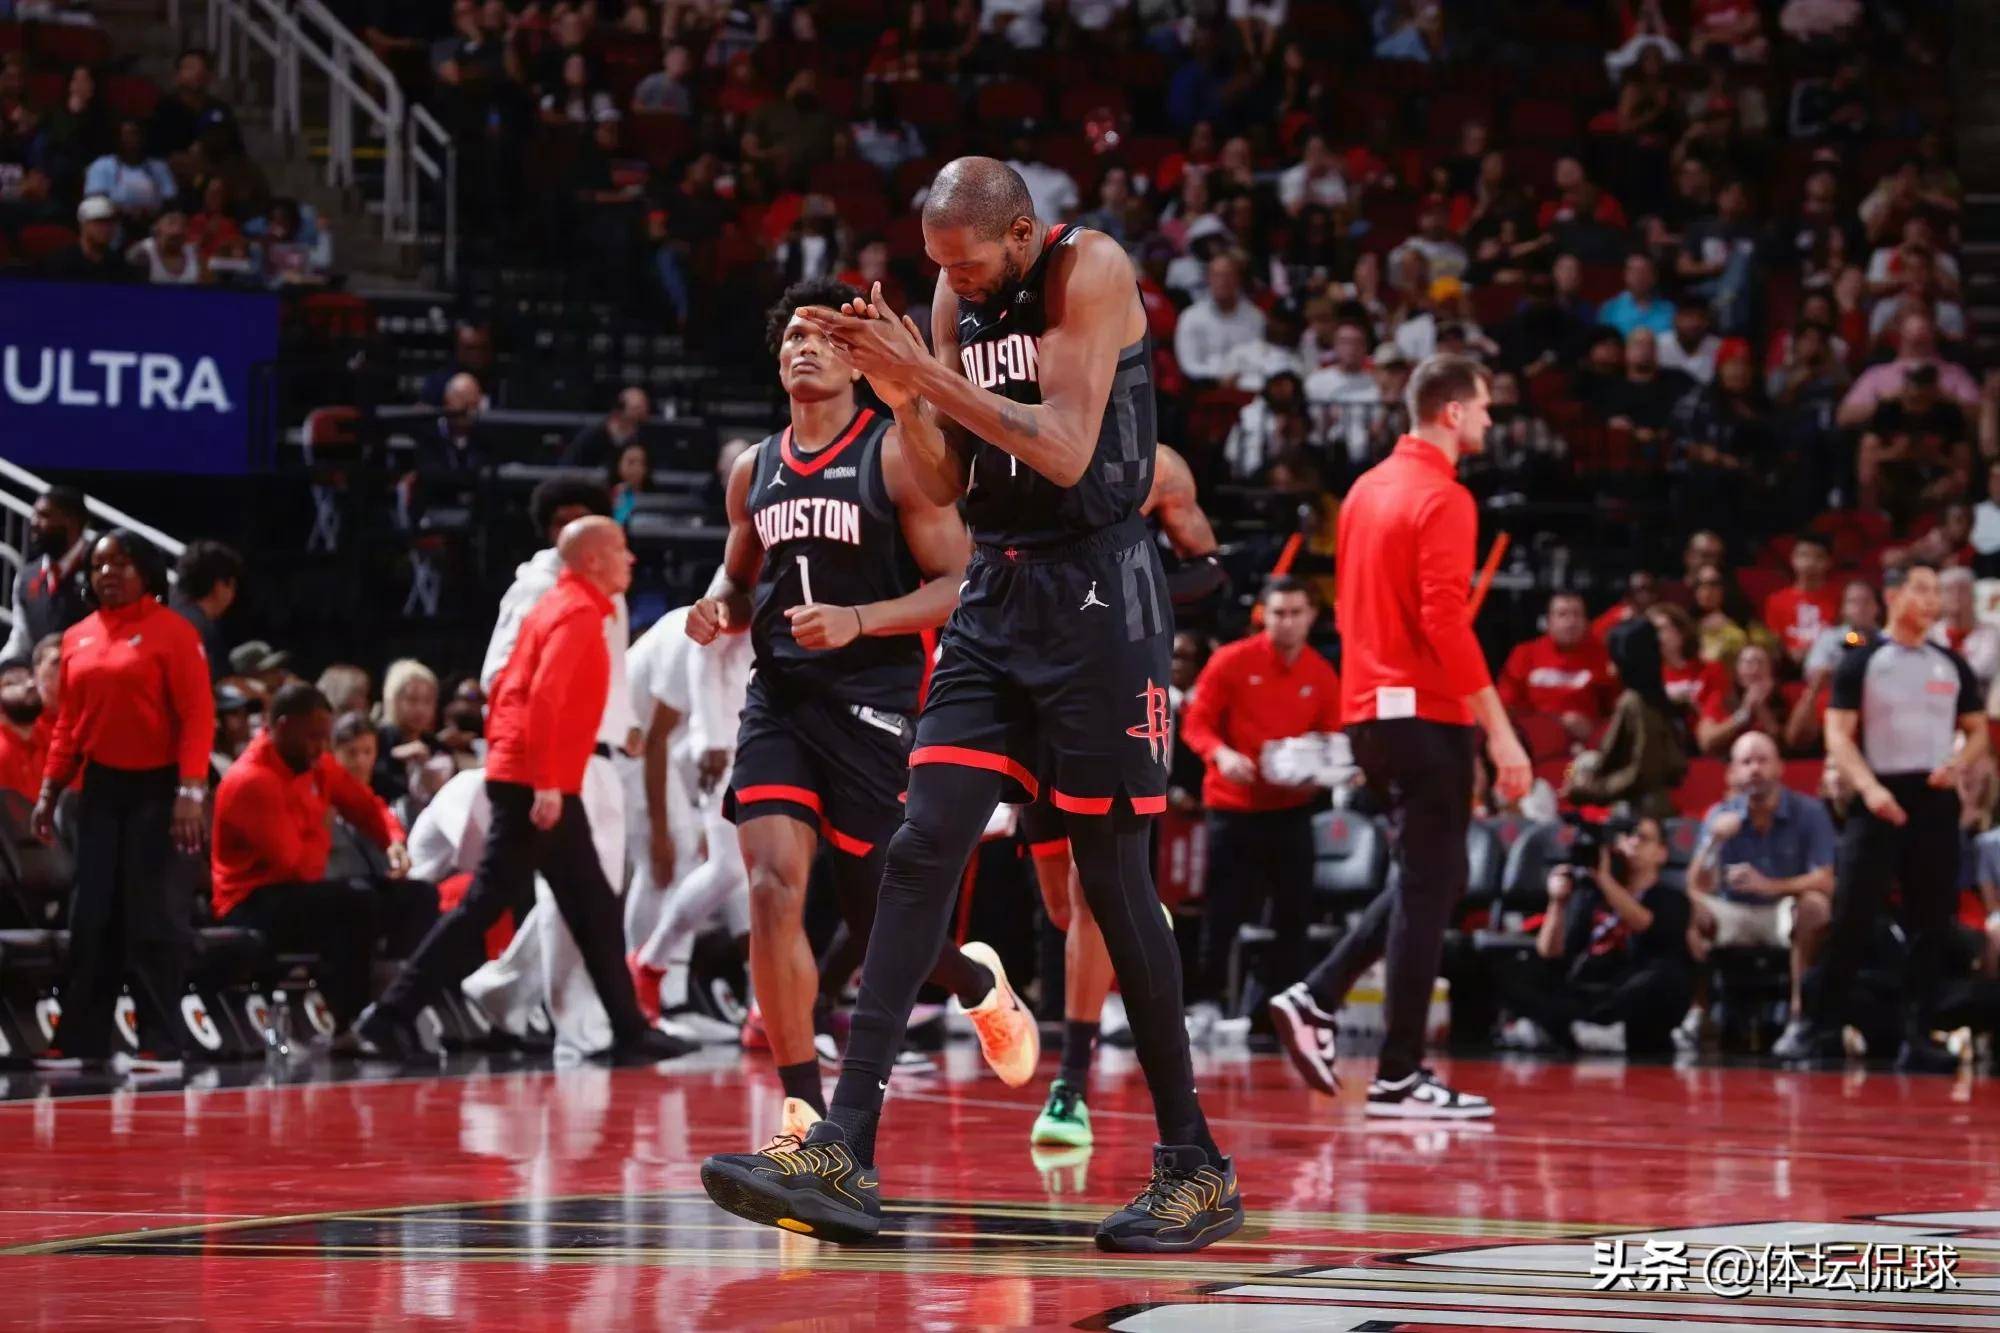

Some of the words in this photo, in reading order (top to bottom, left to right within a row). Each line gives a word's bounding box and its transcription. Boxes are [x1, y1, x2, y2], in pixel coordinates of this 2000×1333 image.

[3, 345, 233, 413] ULTRA
[961, 334, 1040, 389] OUSON
[753, 498, 861, 550] HOUSTON
[795, 555, 814, 605] 1
